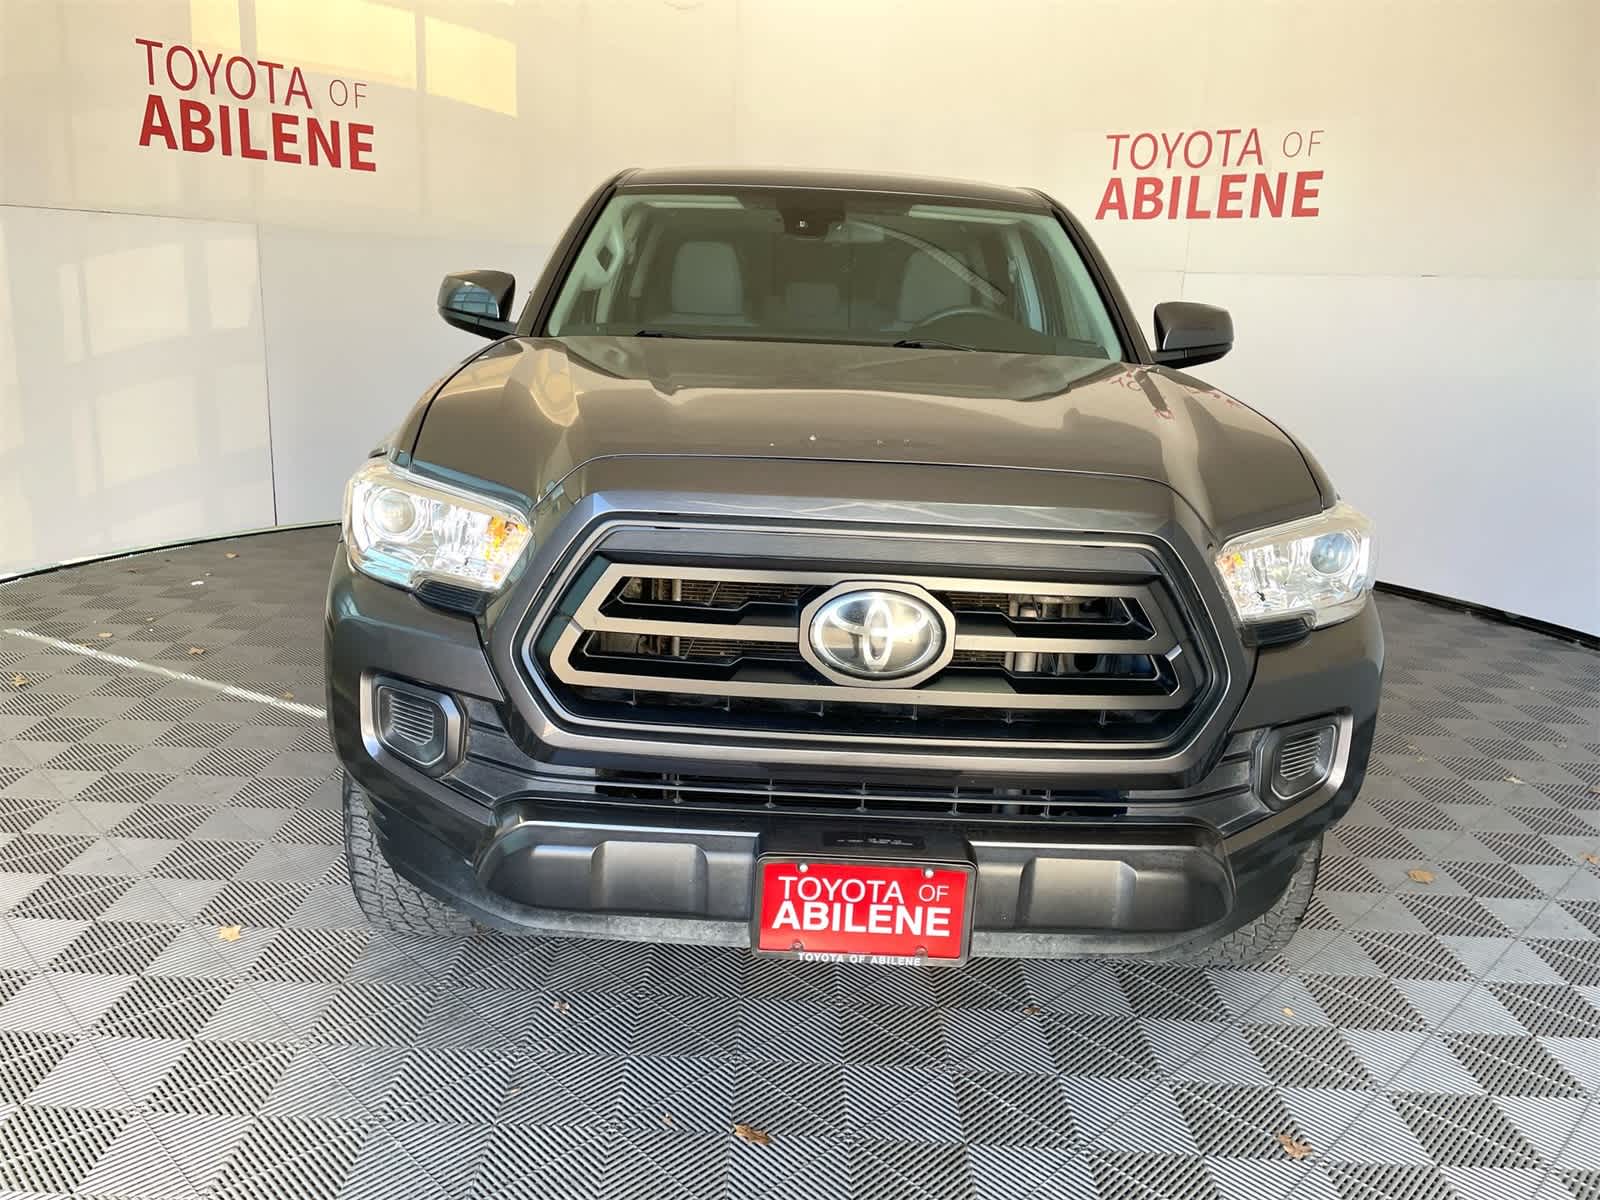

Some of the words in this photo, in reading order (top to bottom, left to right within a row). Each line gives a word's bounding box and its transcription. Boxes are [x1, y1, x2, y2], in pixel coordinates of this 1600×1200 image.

[135, 38, 313, 110] TOYOTA
[329, 79, 367, 109] OF
[138, 94, 377, 172] ABILENE
[1106, 128, 1263, 170] TOYOTA
[1282, 130, 1325, 158] OF
[1095, 170, 1324, 220] ABILENE
[778, 876, 904, 904] TOYOTA
[918, 884, 949, 902] OF
[771, 901, 951, 937] ABILENE
[798, 952, 844, 963] TOYOTA
[850, 955, 865, 964] OF
[870, 956, 921, 967] ABILENE
